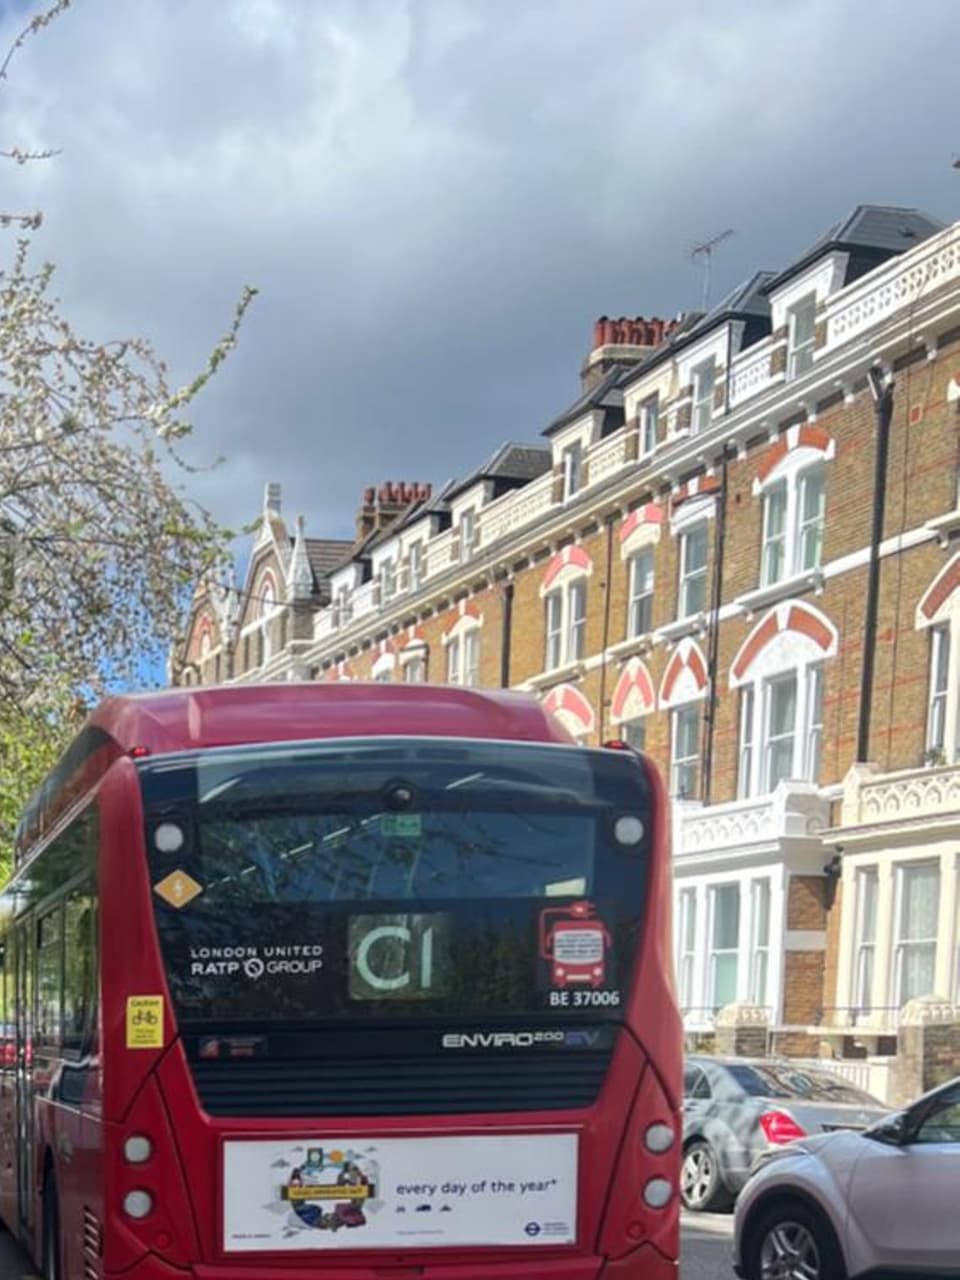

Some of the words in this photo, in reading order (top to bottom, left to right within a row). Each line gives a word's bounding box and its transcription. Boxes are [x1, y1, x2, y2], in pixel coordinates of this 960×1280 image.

[191, 947, 257, 958] LONDON
[263, 945, 323, 957] UNITED
[356, 925, 433, 990] C1
[190, 961, 240, 975] RATP
[266, 959, 323, 974] GROUP
[549, 991, 569, 1006] BE
[573, 990, 621, 1006] 37006
[396, 1183, 437, 1196] every
[441, 1181, 467, 1196] day
[471, 1179, 487, 1193] of
[491, 1179, 516, 1192] the
